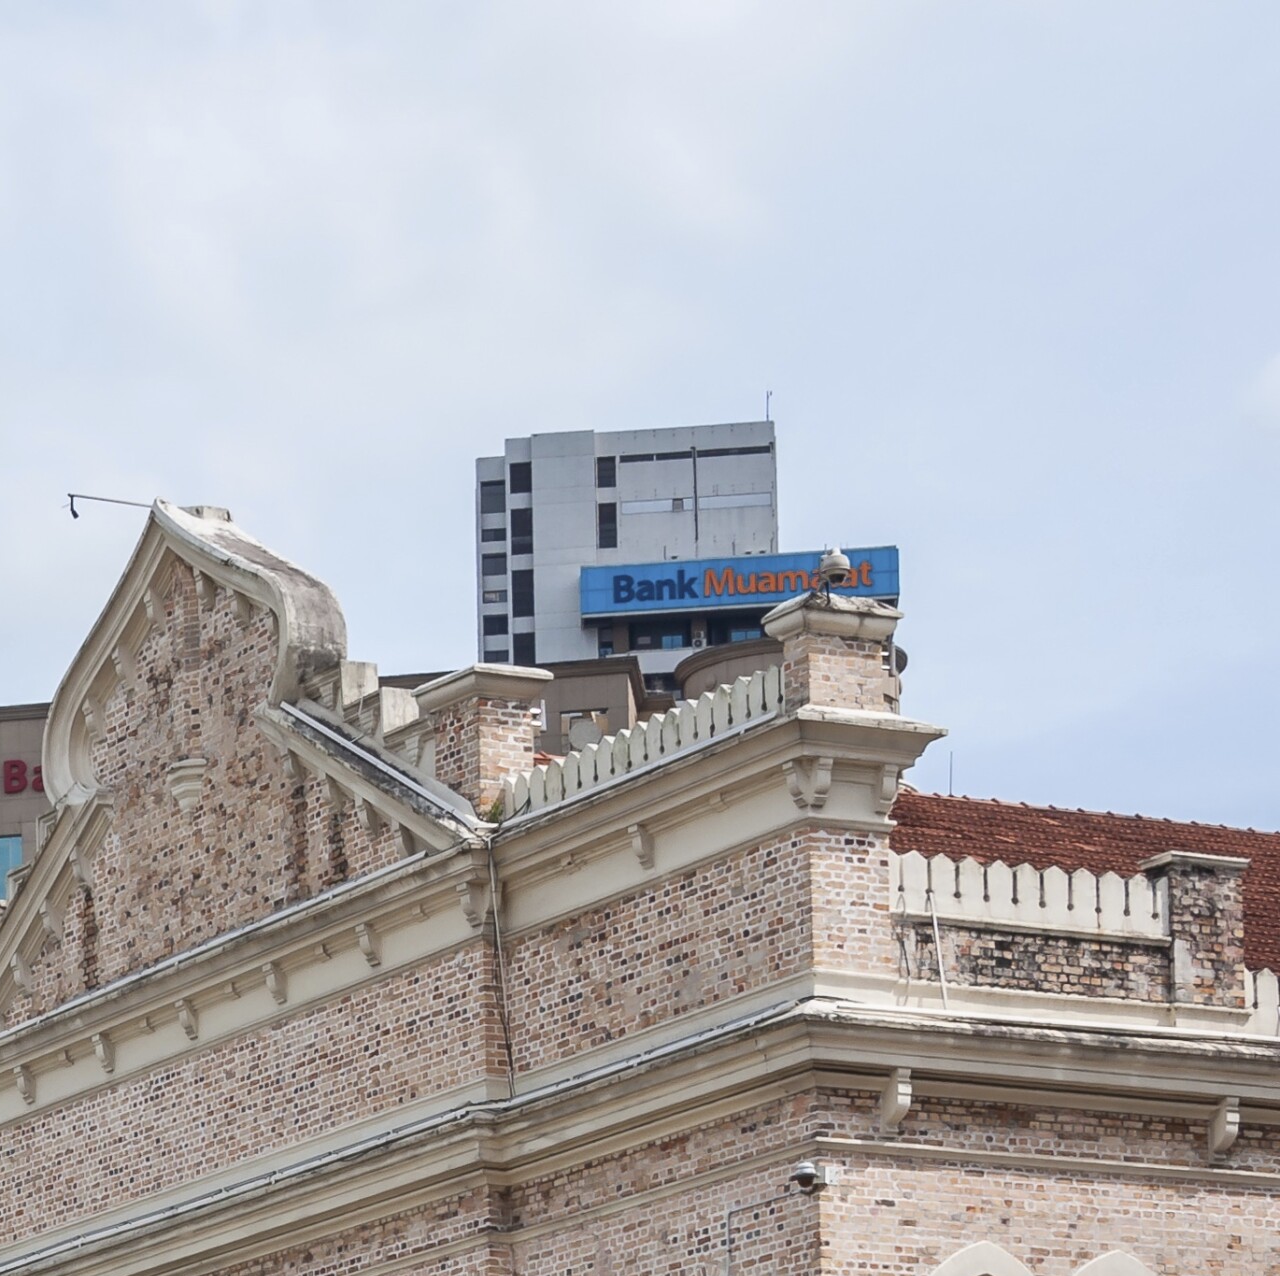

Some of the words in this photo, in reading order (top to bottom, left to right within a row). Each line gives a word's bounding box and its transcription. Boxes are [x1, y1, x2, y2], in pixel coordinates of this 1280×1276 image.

[613, 570, 700, 604] Bank
[704, 560, 873, 597] Muamat
[3, 759, 45, 795] Ba
